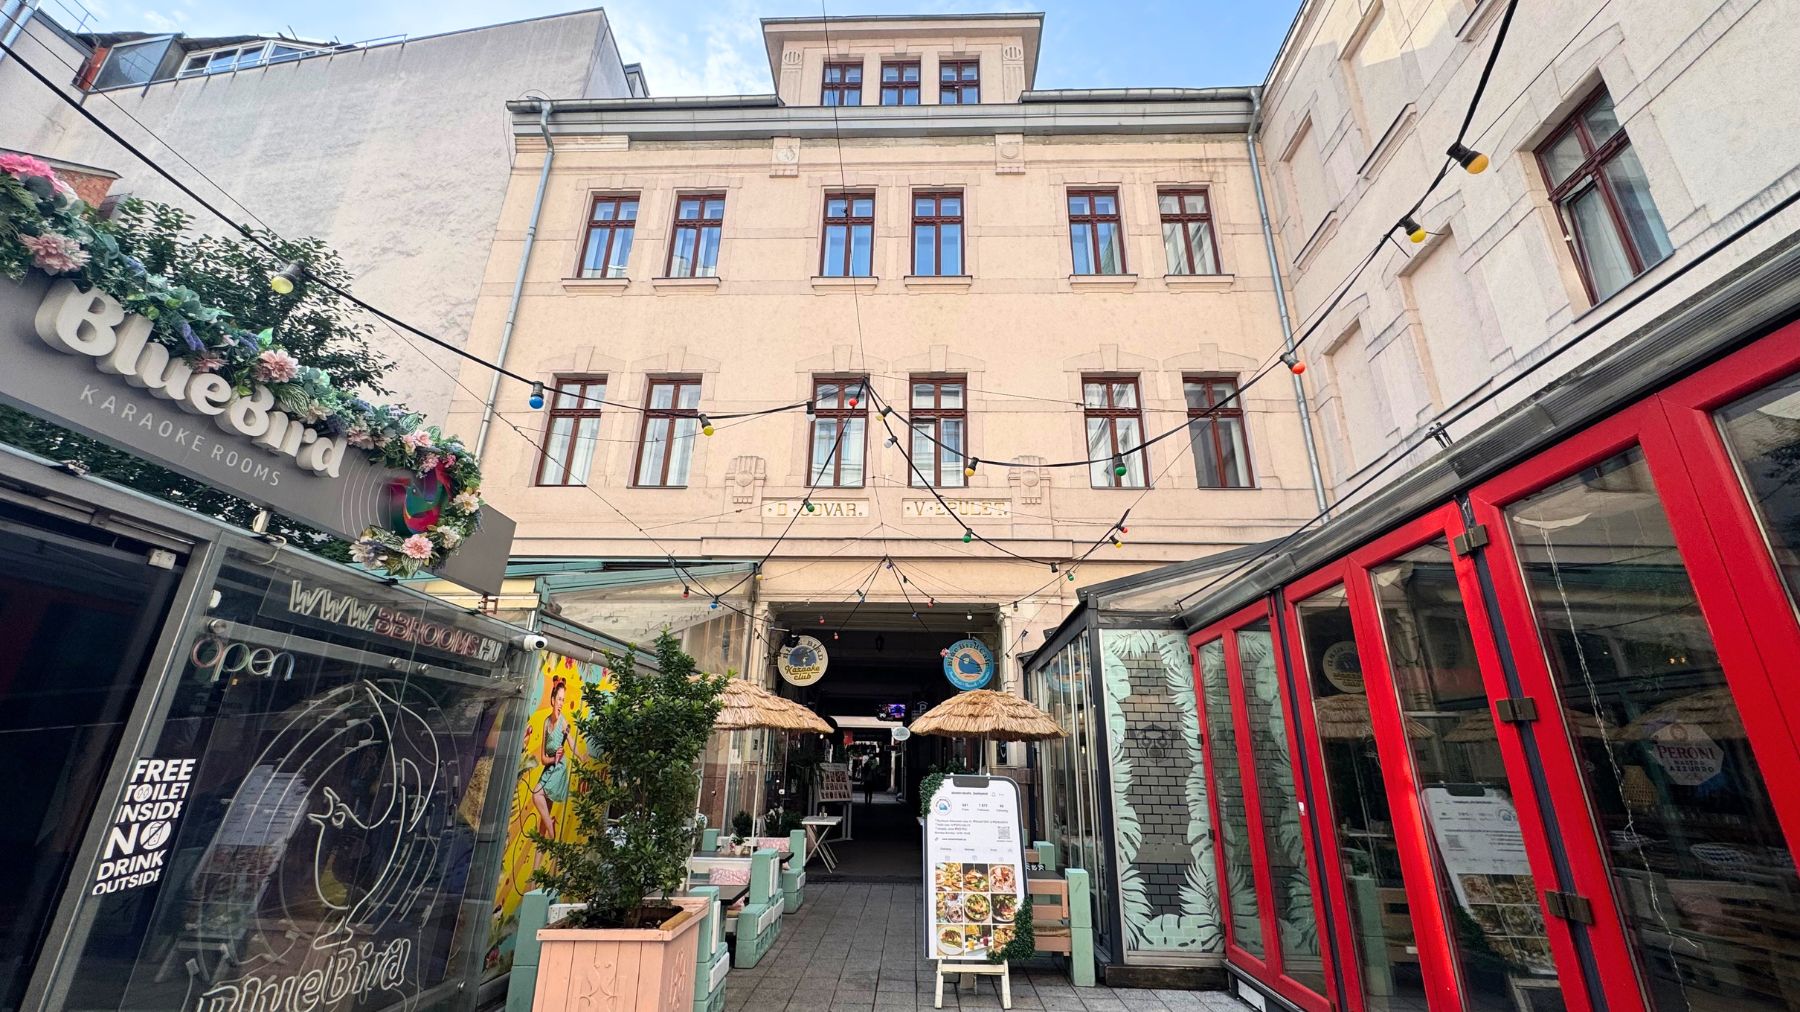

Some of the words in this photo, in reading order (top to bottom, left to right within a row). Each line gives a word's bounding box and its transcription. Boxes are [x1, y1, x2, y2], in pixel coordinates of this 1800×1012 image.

[35, 281, 348, 479] BlueBird
[80, 384, 206, 453] KARAOKE
[210, 445, 281, 487] ROOMS
[784, 663, 820, 675] Karaoke
[1657, 745, 1716, 760] PERONI
[130, 758, 197, 783] FREE
[96, 849, 168, 882] DRINK
